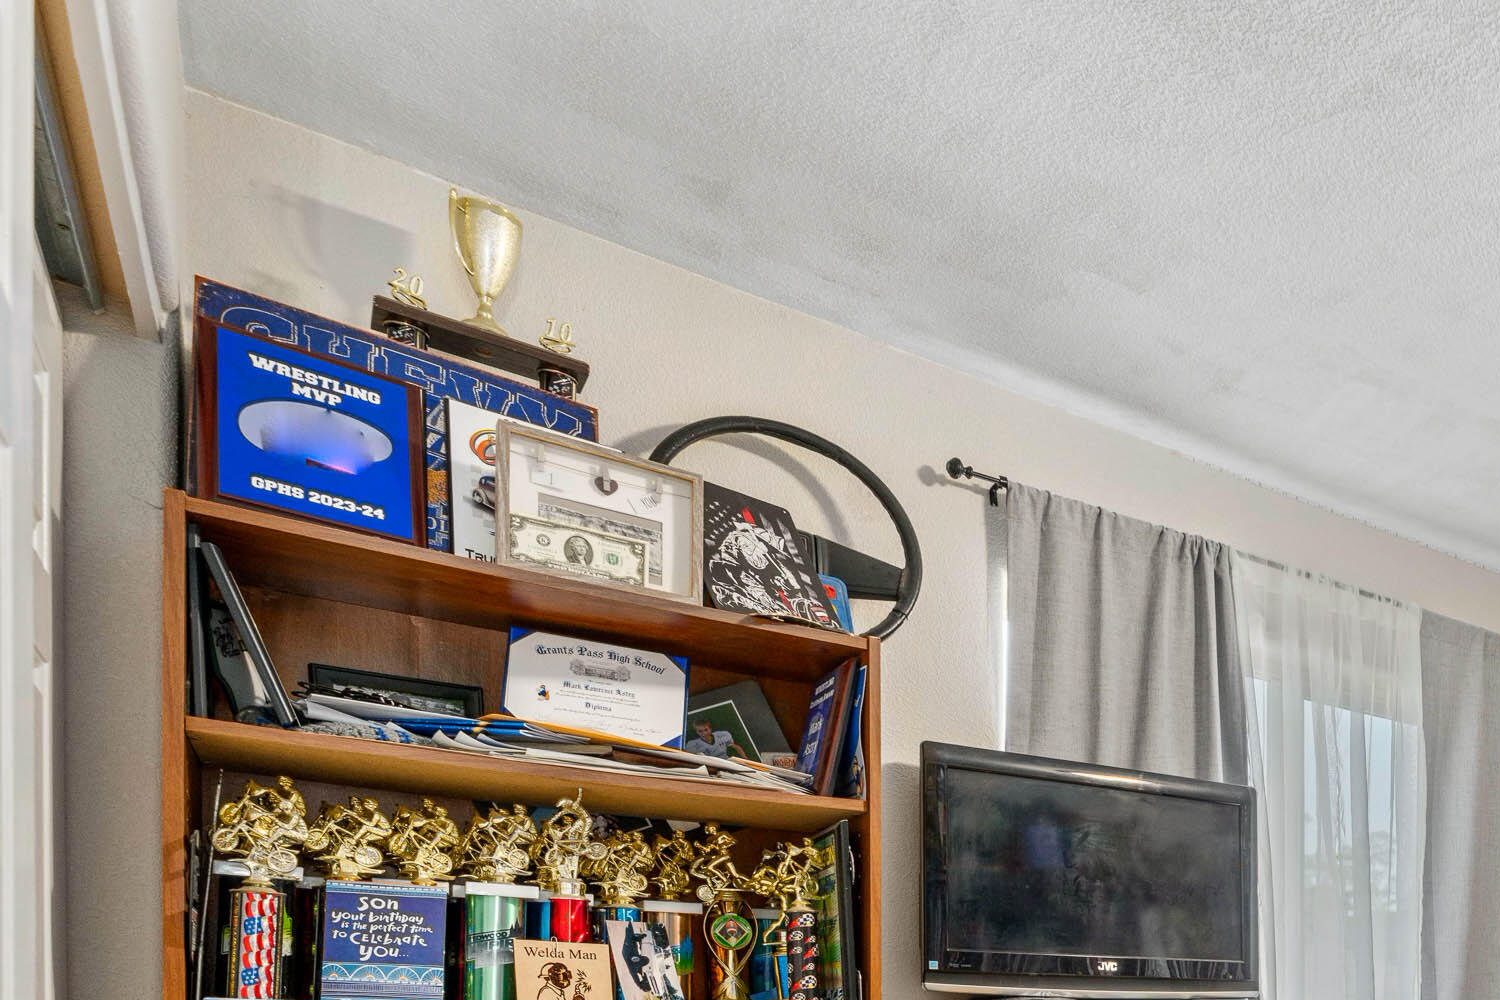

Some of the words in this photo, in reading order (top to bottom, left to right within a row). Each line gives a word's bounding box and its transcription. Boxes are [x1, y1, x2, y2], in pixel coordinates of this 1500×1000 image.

[249, 353, 382, 405] WRESTLING
[291, 382, 342, 406] MVP
[250, 476, 305, 500] GPHS
[308, 491, 386, 520] 2023-24
[536, 643, 574, 655] Grants
[576, 646, 604, 659] Pass
[607, 650, 630, 665] High
[632, 655, 666, 675] School
[332, 911, 366, 923] your
[352, 921, 368, 930] the
[370, 922, 408, 933] perfect
[410, 925, 433, 933] time
[524, 946, 565, 959] Welda
[569, 949, 597, 960] Man
[1098, 961, 1118, 972] JVC
